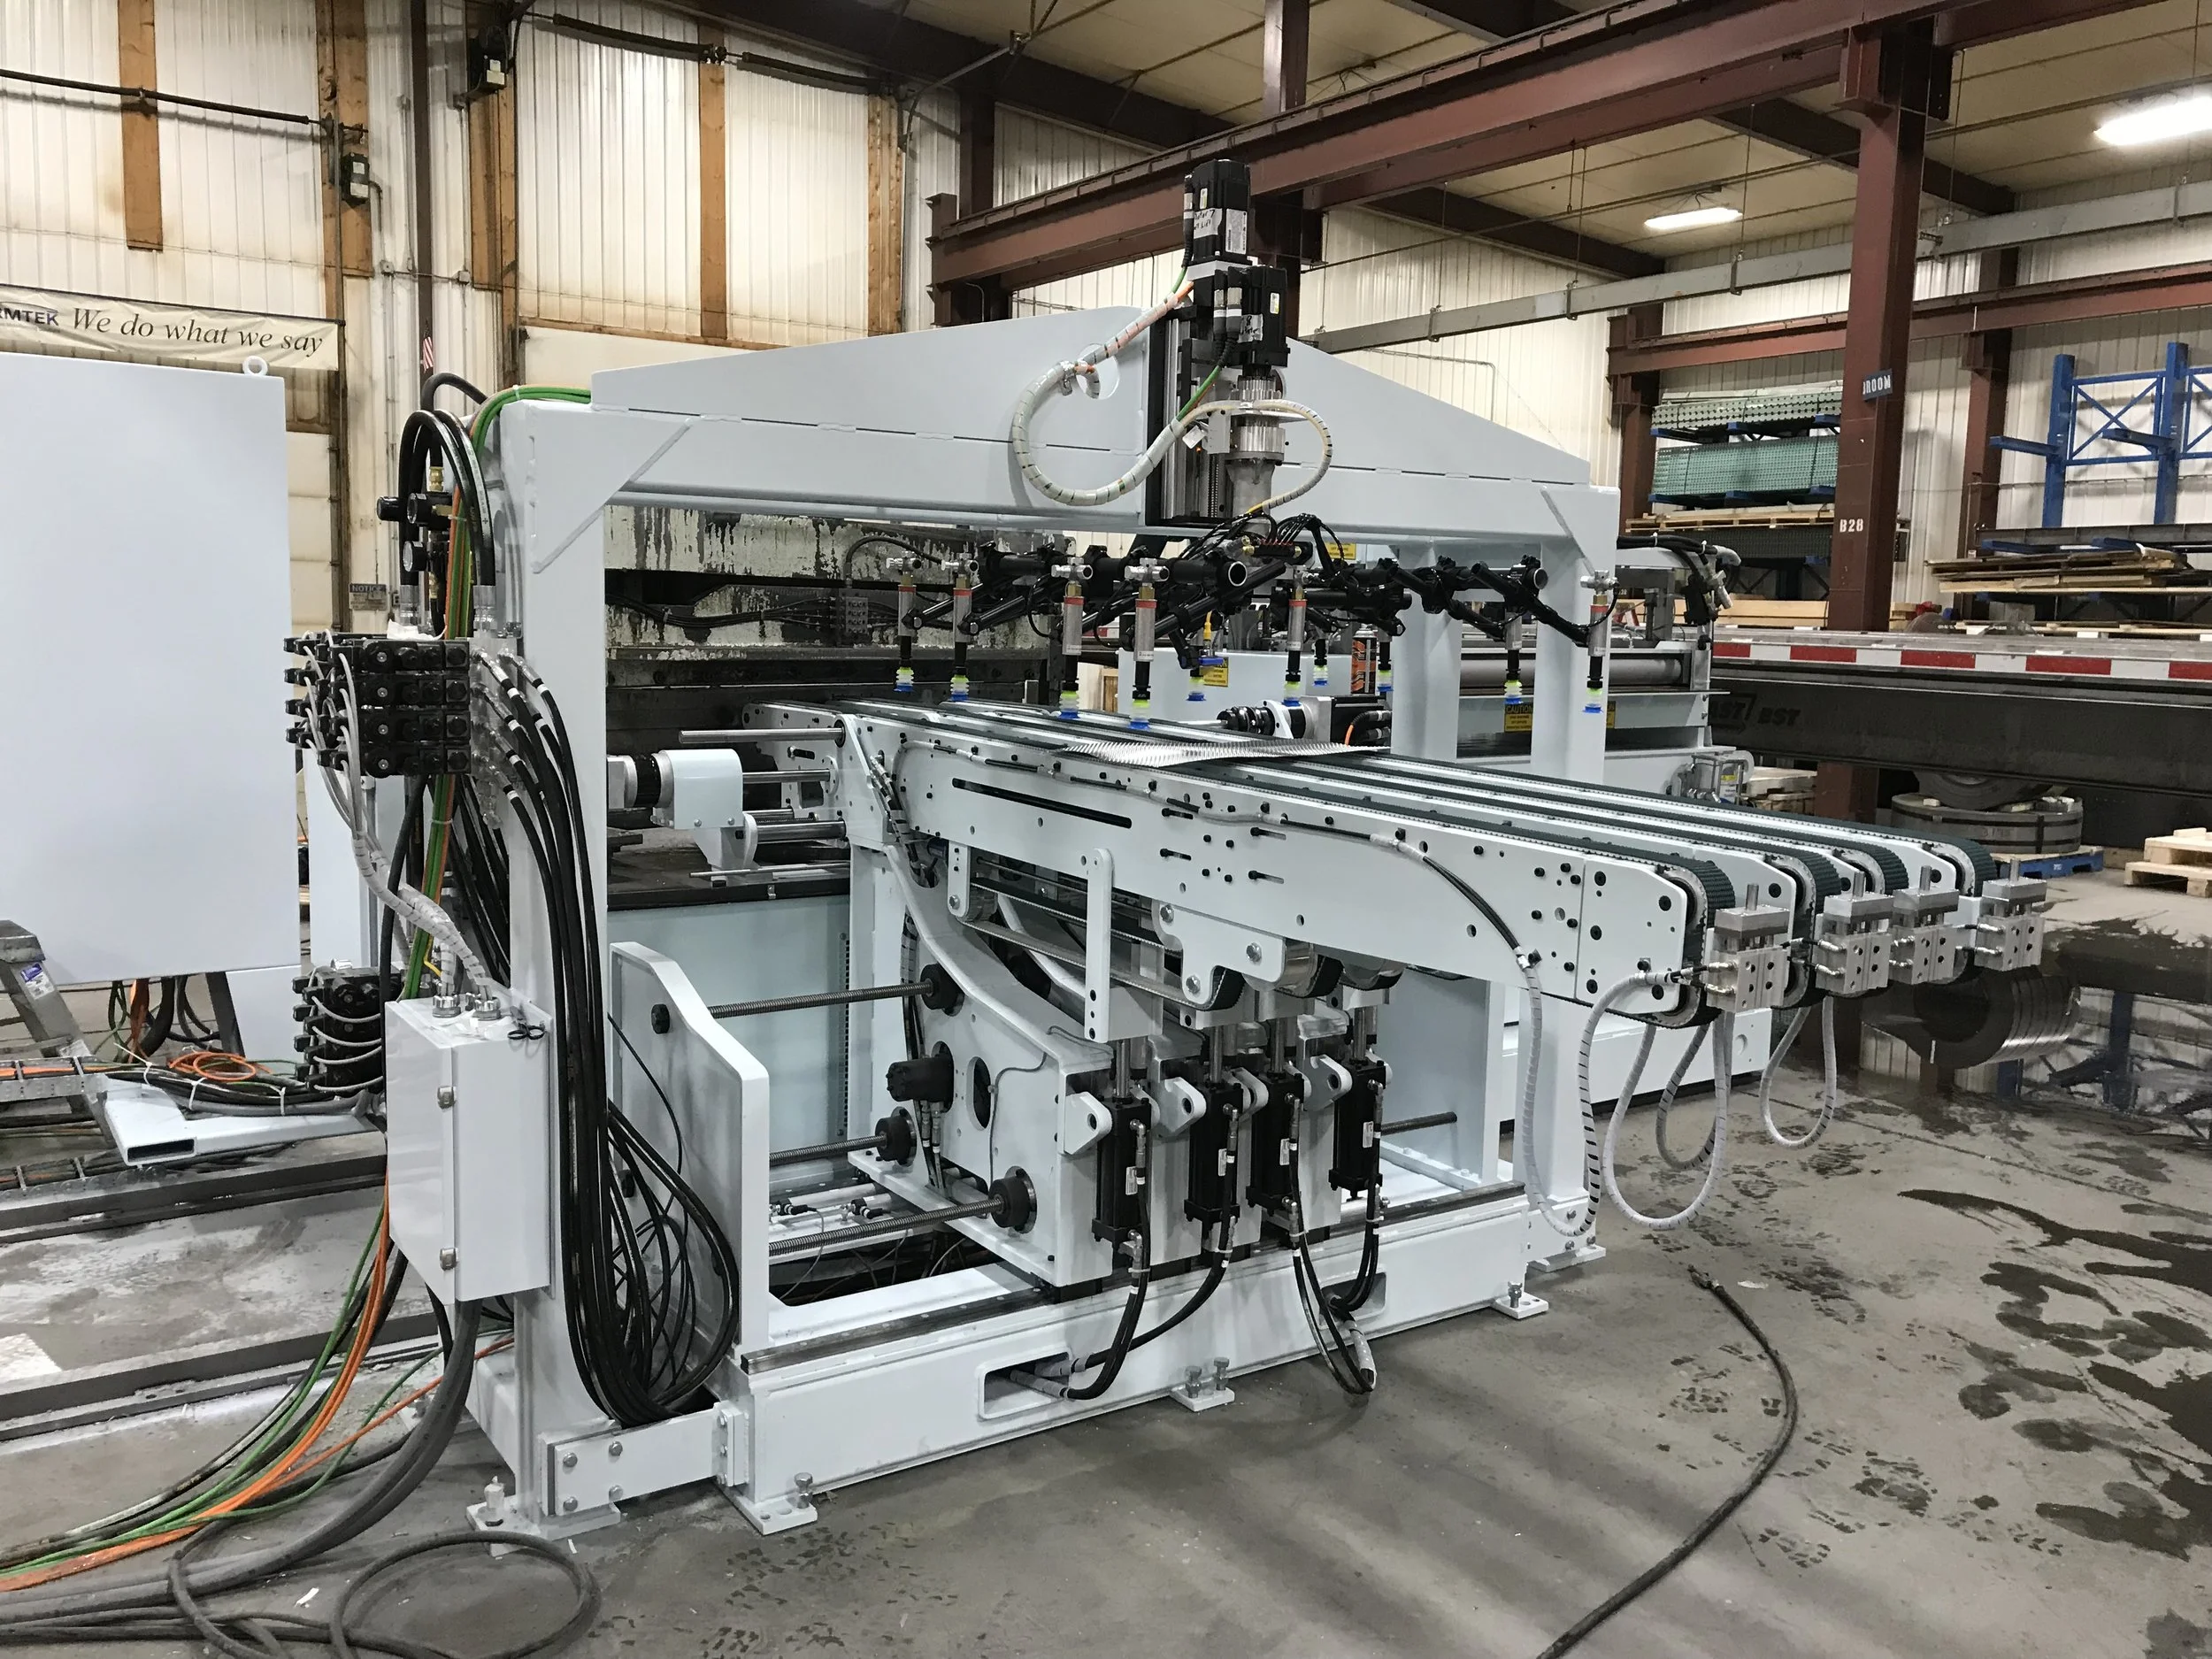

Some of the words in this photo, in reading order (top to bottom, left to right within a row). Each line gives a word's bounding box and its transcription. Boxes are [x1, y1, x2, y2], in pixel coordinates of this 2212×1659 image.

[0, 307, 59, 326] MTEK
[73, 307, 111, 334] We
[120, 313, 154, 337] do
[165, 319, 230, 344] what
[238, 331, 273, 348] we
[280, 334, 323, 357] say
[1839, 518, 1864, 533] B28
